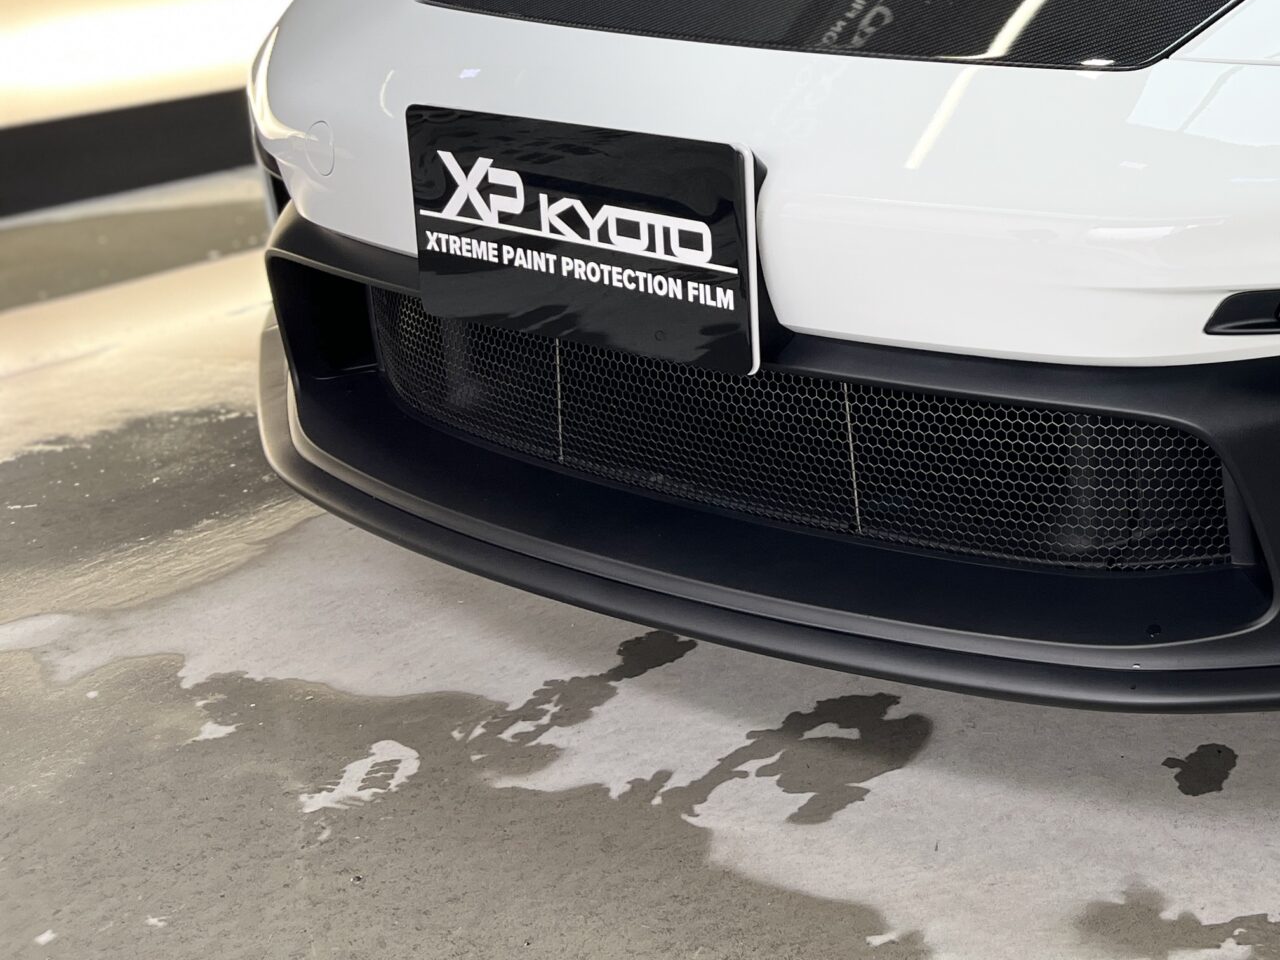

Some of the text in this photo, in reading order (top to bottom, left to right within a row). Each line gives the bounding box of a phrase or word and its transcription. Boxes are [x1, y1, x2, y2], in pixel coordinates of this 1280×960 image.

[436, 149, 713, 265] XP KYOTO
[425, 230, 735, 311] XTREME PAINT PROTECTION FILM
